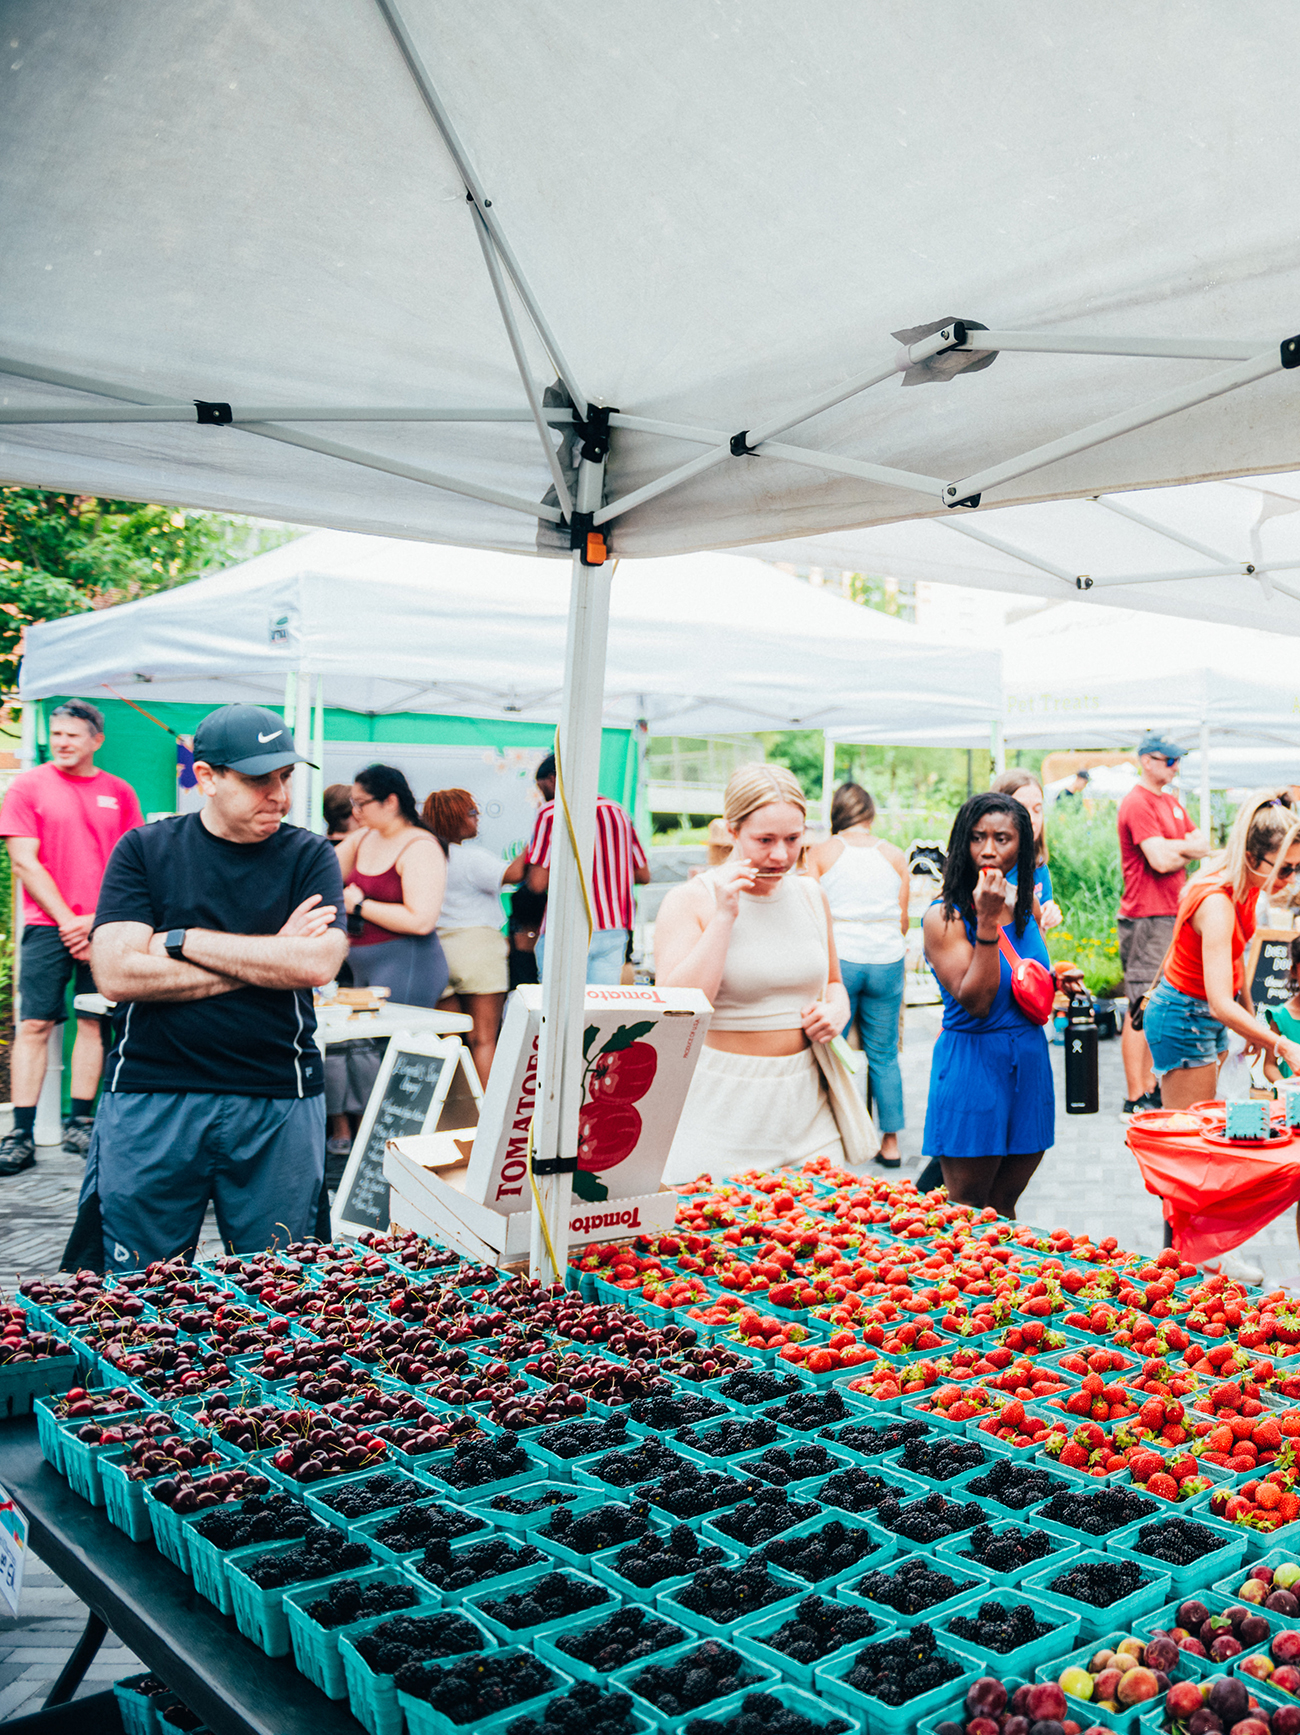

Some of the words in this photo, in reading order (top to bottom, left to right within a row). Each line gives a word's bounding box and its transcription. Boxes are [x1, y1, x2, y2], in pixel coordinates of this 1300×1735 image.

[1007, 695, 1034, 713] Pet
[1041, 694, 1100, 712] Treats
[586, 989, 666, 1005] Tomato
[495, 1035, 540, 1202] TOMATO
[569, 1207, 642, 1235] Tomato
